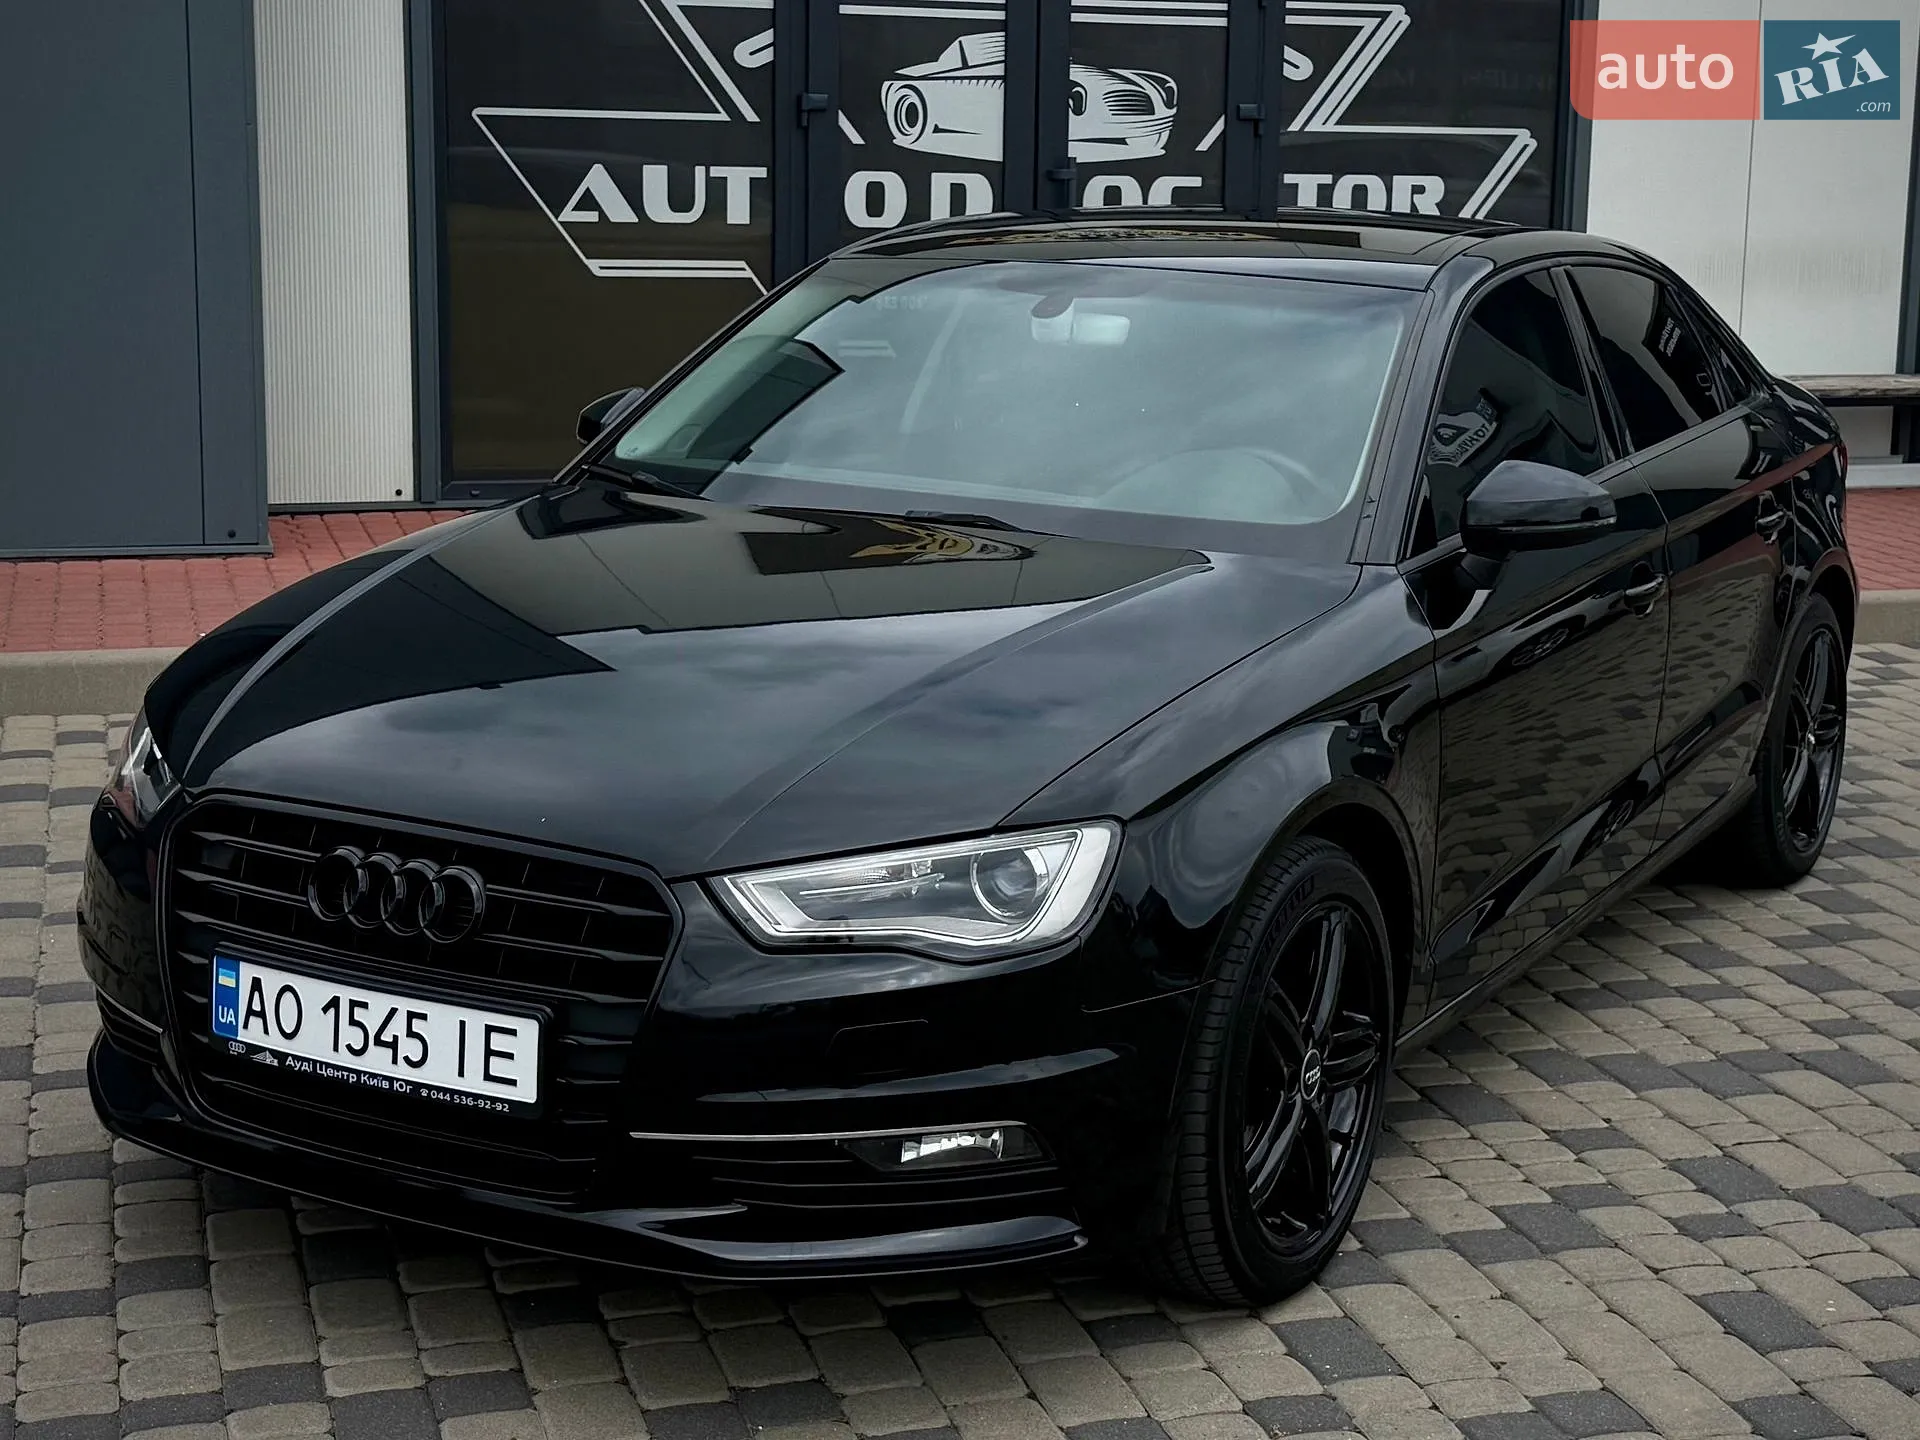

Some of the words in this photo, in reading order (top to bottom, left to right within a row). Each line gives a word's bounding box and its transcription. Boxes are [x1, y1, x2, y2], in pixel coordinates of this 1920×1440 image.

[218, 1005, 236, 1026] UA
[242, 976, 303, 1041] AO
[320, 995, 429, 1069] 1545
[457, 1019, 519, 1087] IE
[285, 1056, 313, 1074] Ауді
[316, 1062, 358, 1084] Центр
[360, 1073, 390, 1090] Київ
[392, 1080, 414, 1097] Юг
[430, 1090, 451, 1102] 044
[453, 1095, 511, 1113] 536-92-92
